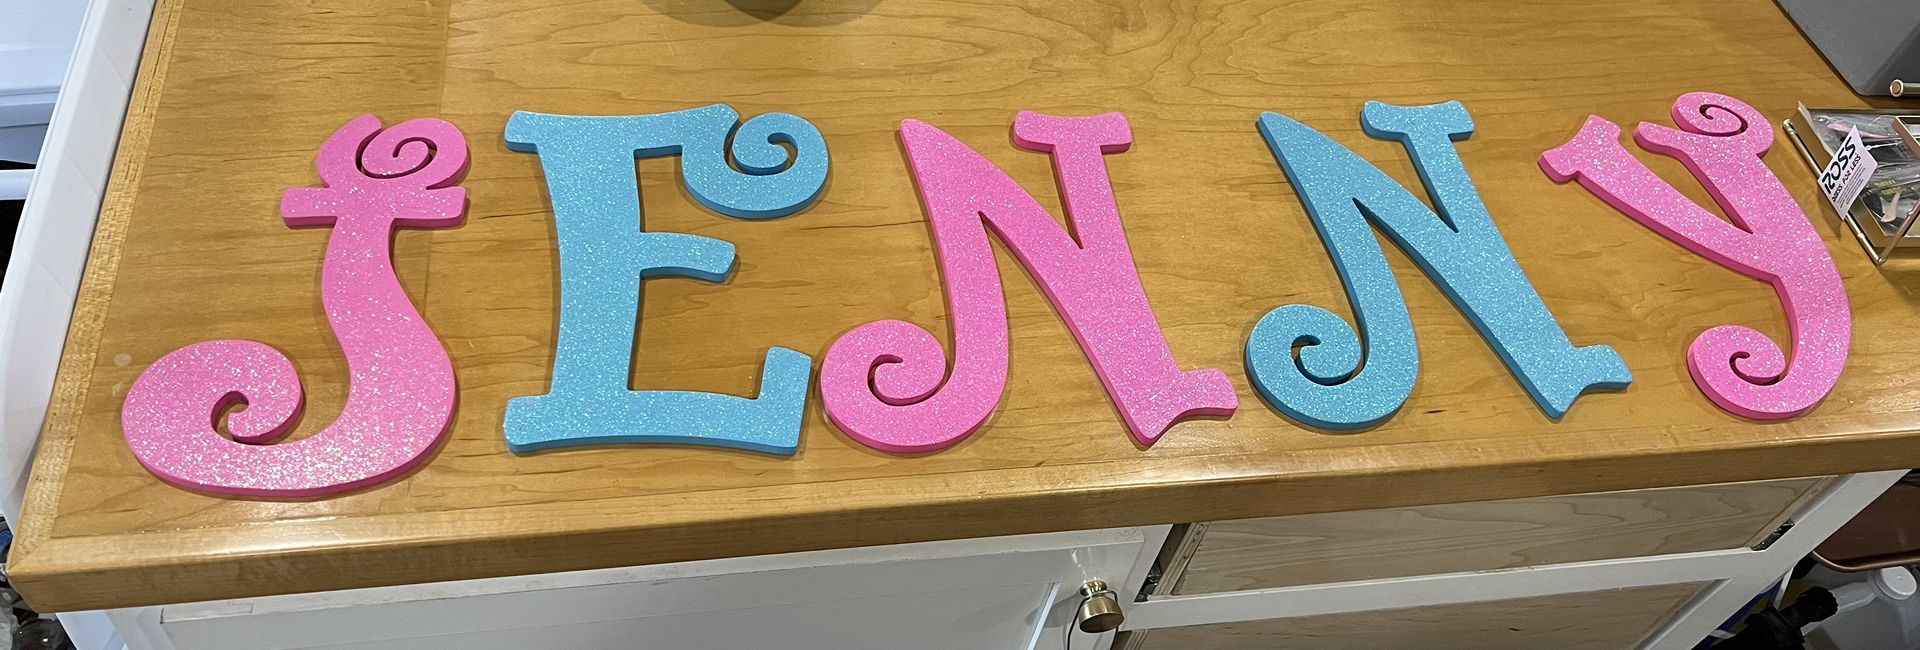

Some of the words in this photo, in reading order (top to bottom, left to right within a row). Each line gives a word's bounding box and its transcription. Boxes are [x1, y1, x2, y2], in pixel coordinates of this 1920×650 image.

[1821, 136, 1856, 195] ROSS
[1842, 171, 1852, 185] FOR
[1849, 154, 1862, 172] LESS
[121, 91, 1853, 499] JENNY
